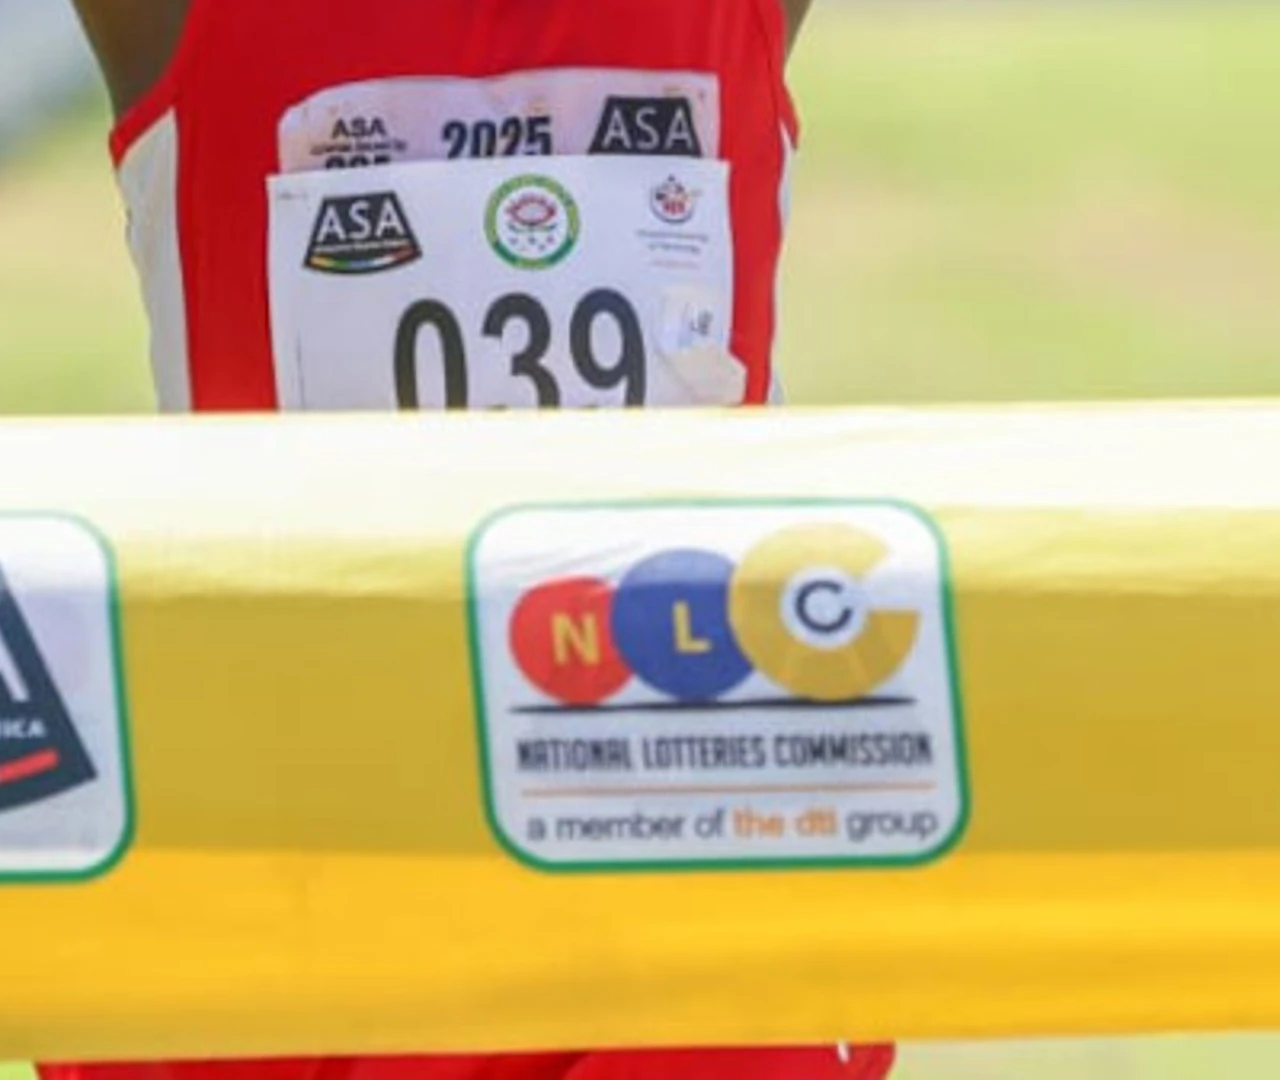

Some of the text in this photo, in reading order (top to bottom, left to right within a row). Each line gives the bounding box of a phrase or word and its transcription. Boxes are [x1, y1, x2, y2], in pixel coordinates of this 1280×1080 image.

[332, 118, 386, 138] ASA
[601, 107, 694, 150] ASA
[317, 198, 406, 242] ASA
[392, 287, 646, 411] 039
[516, 733, 932, 772] NATIONAL LOTTERIES COMMISSION
[527, 816, 548, 839] a
[556, 807, 683, 838] member
[695, 804, 728, 837] of
[733, 805, 784, 836] the
[848, 807, 938, 843] group
